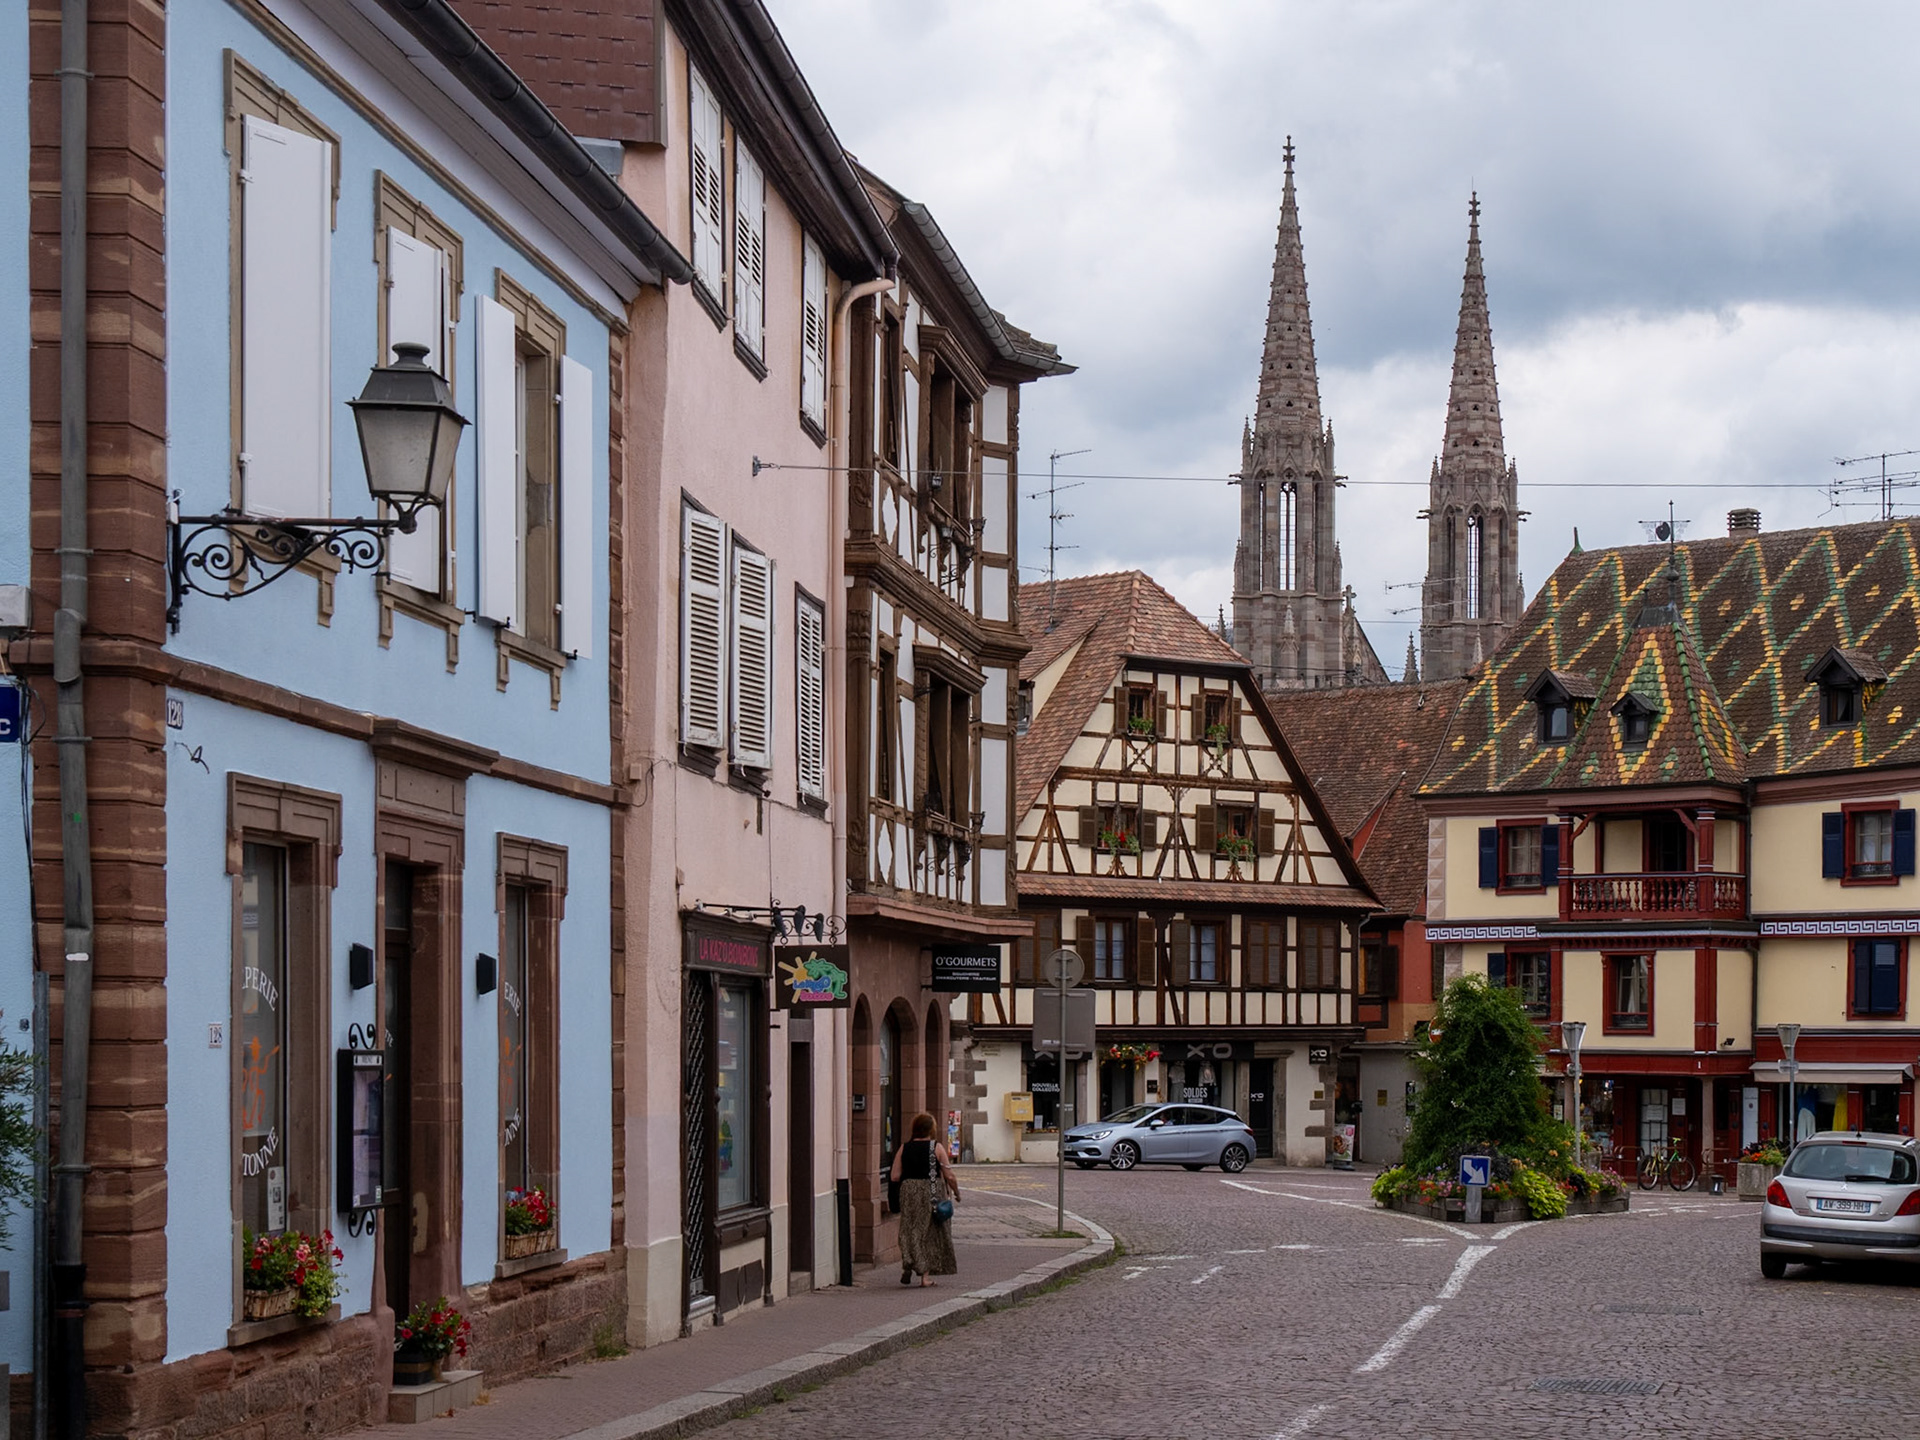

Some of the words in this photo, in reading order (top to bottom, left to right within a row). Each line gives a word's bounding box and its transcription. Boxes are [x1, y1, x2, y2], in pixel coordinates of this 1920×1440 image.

[168, 700, 182, 727] 128
[935, 956, 997, 967] O'GOURMETS
[242, 966, 278, 1012] PERIE
[1183, 1087, 1208, 1098] SOLDES
